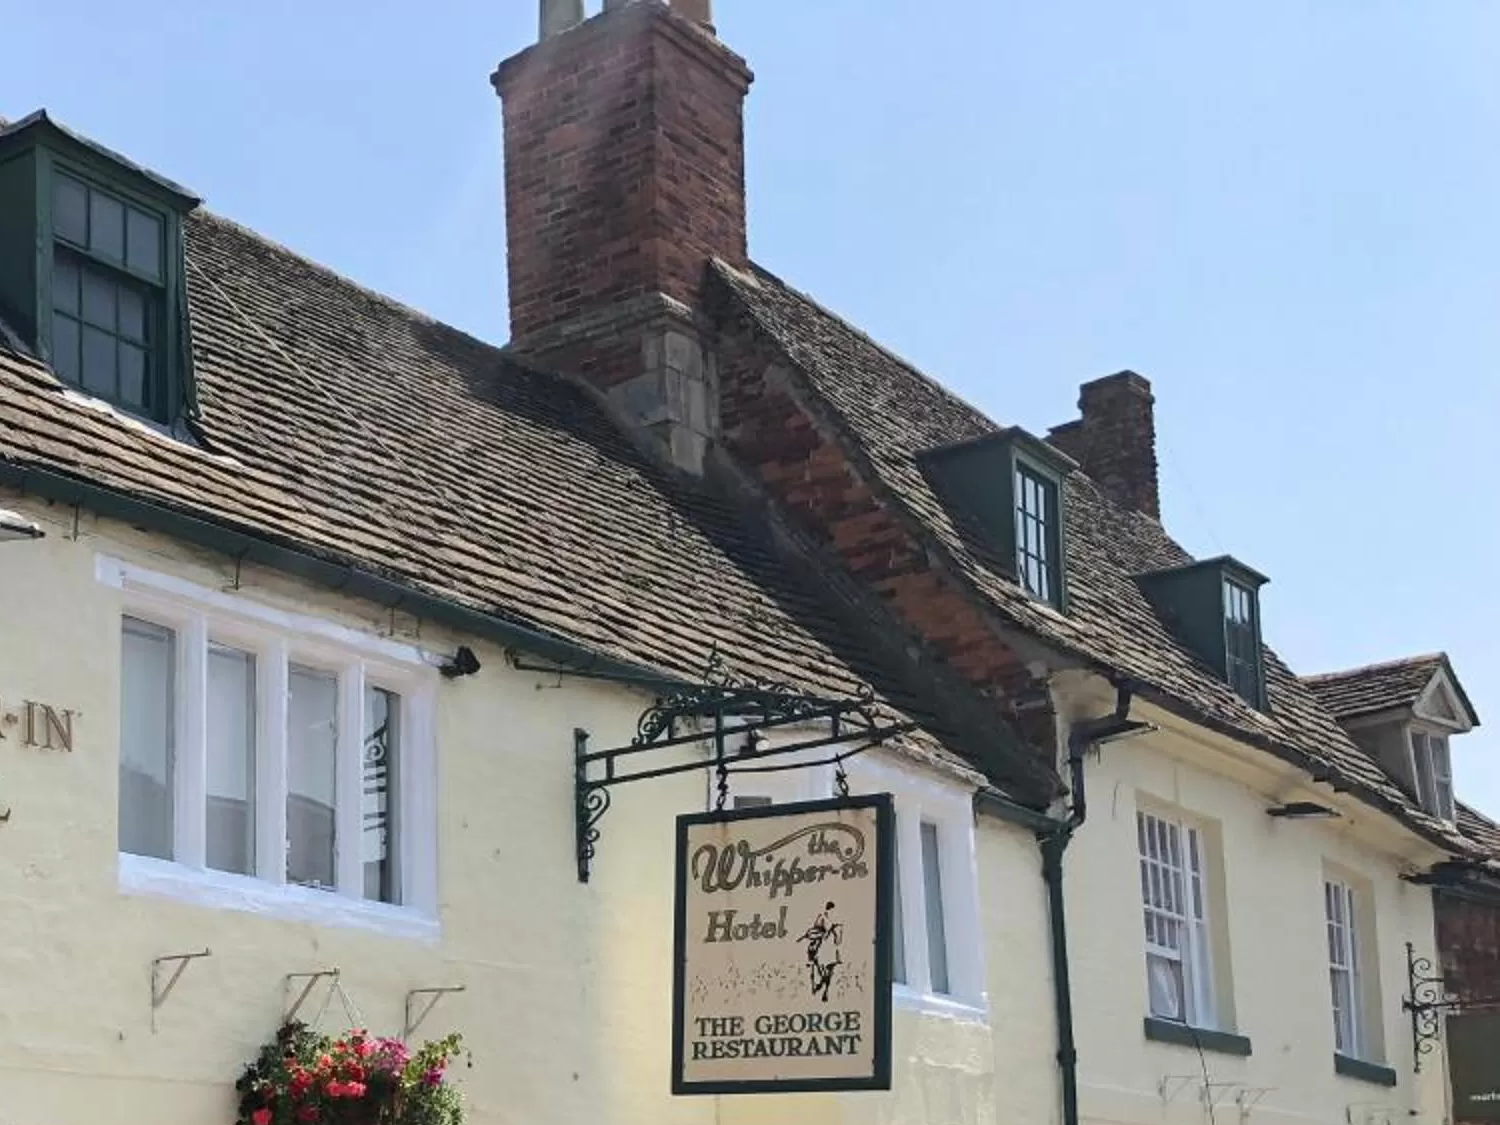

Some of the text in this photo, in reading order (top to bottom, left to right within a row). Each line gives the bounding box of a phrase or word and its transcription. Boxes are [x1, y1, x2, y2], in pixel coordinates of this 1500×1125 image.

[807, 830, 841, 857] the
[703, 905, 789, 943] Hotel
[694, 1010, 862, 1037] THE GEORGE
[691, 1033, 862, 1060] RESTAURANT
